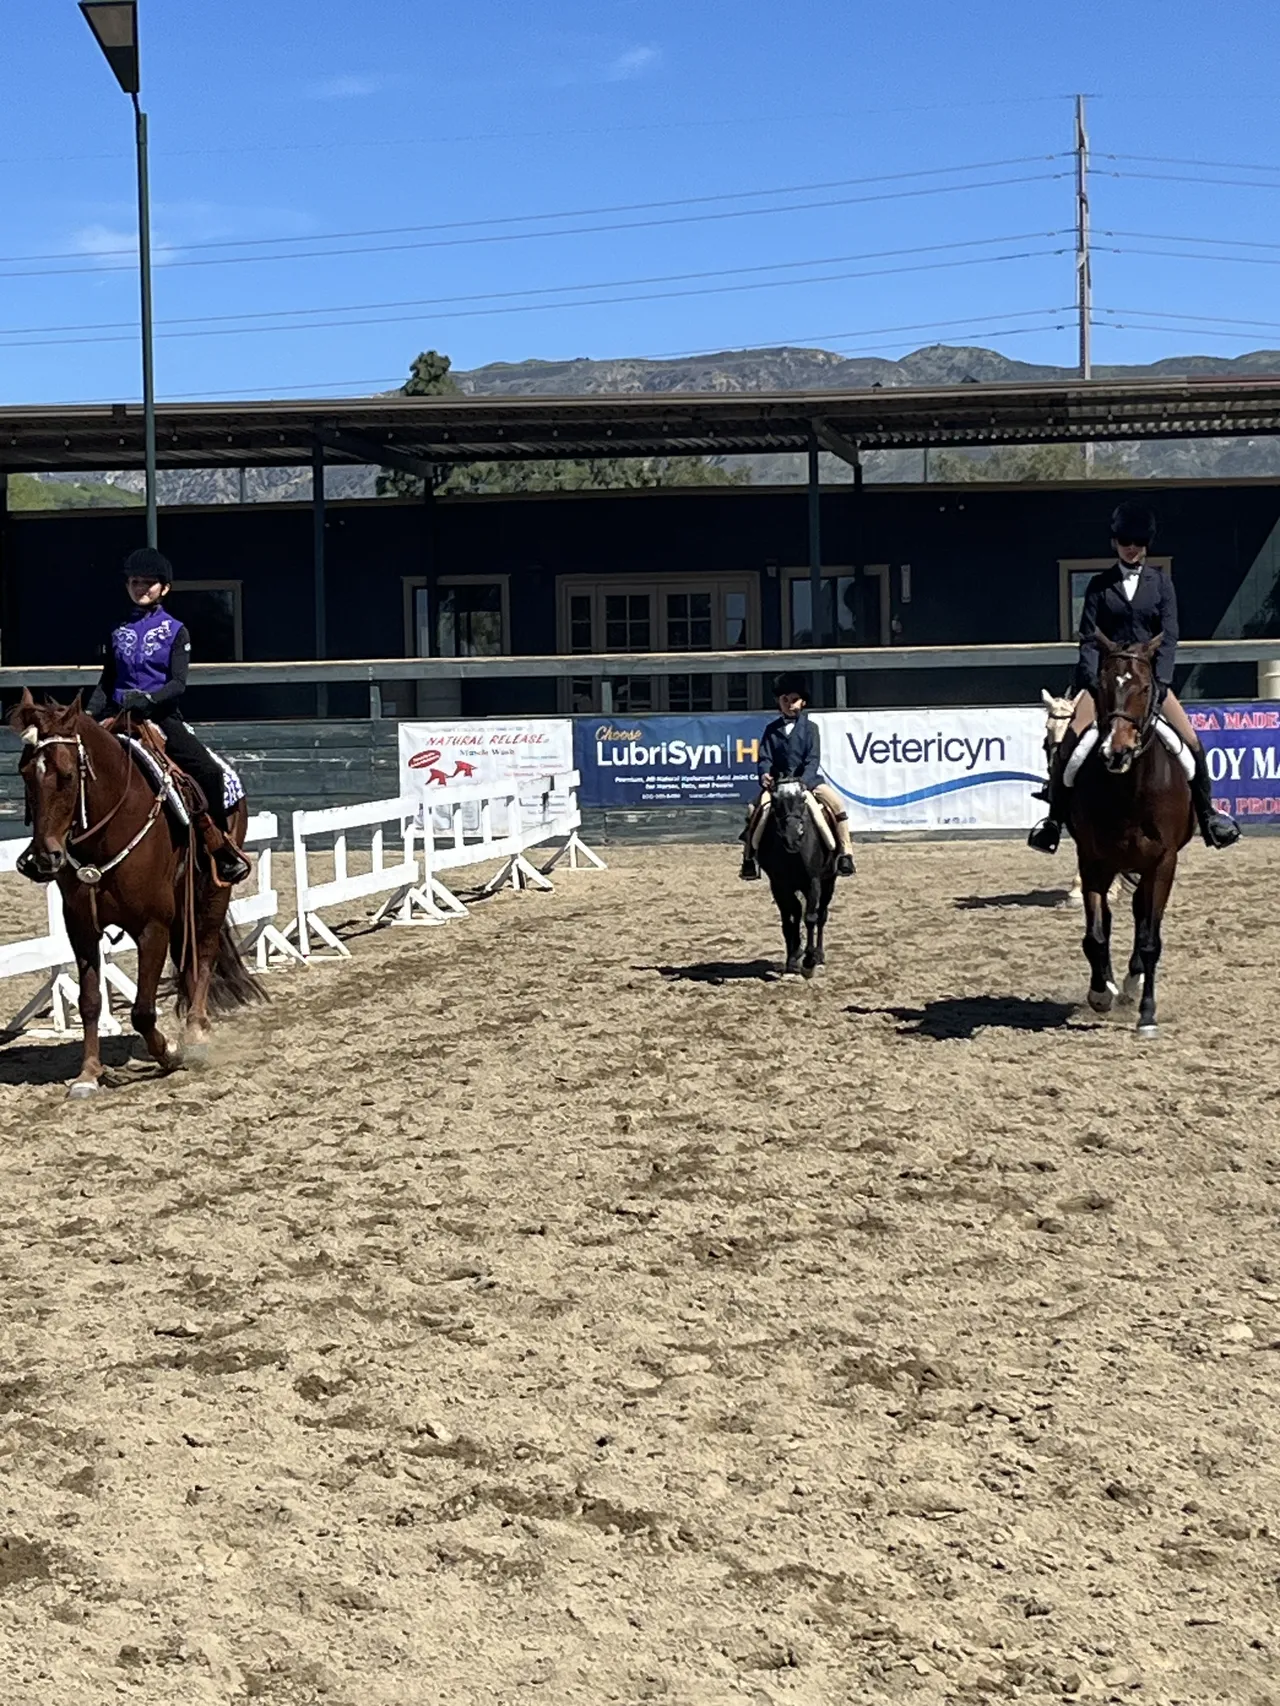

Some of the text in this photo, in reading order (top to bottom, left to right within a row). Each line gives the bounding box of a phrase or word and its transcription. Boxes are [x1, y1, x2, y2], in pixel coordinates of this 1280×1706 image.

[1223, 712, 1280, 730] MADE
[425, 734, 545, 746] NATURAL RELEASE
[595, 726, 643, 741] Choose
[597, 739, 759, 770] LubriSyn H
[846, 732, 1006, 770] Vetericyn
[1206, 747, 1247, 781] OY
[1211, 797, 1232, 814] G
